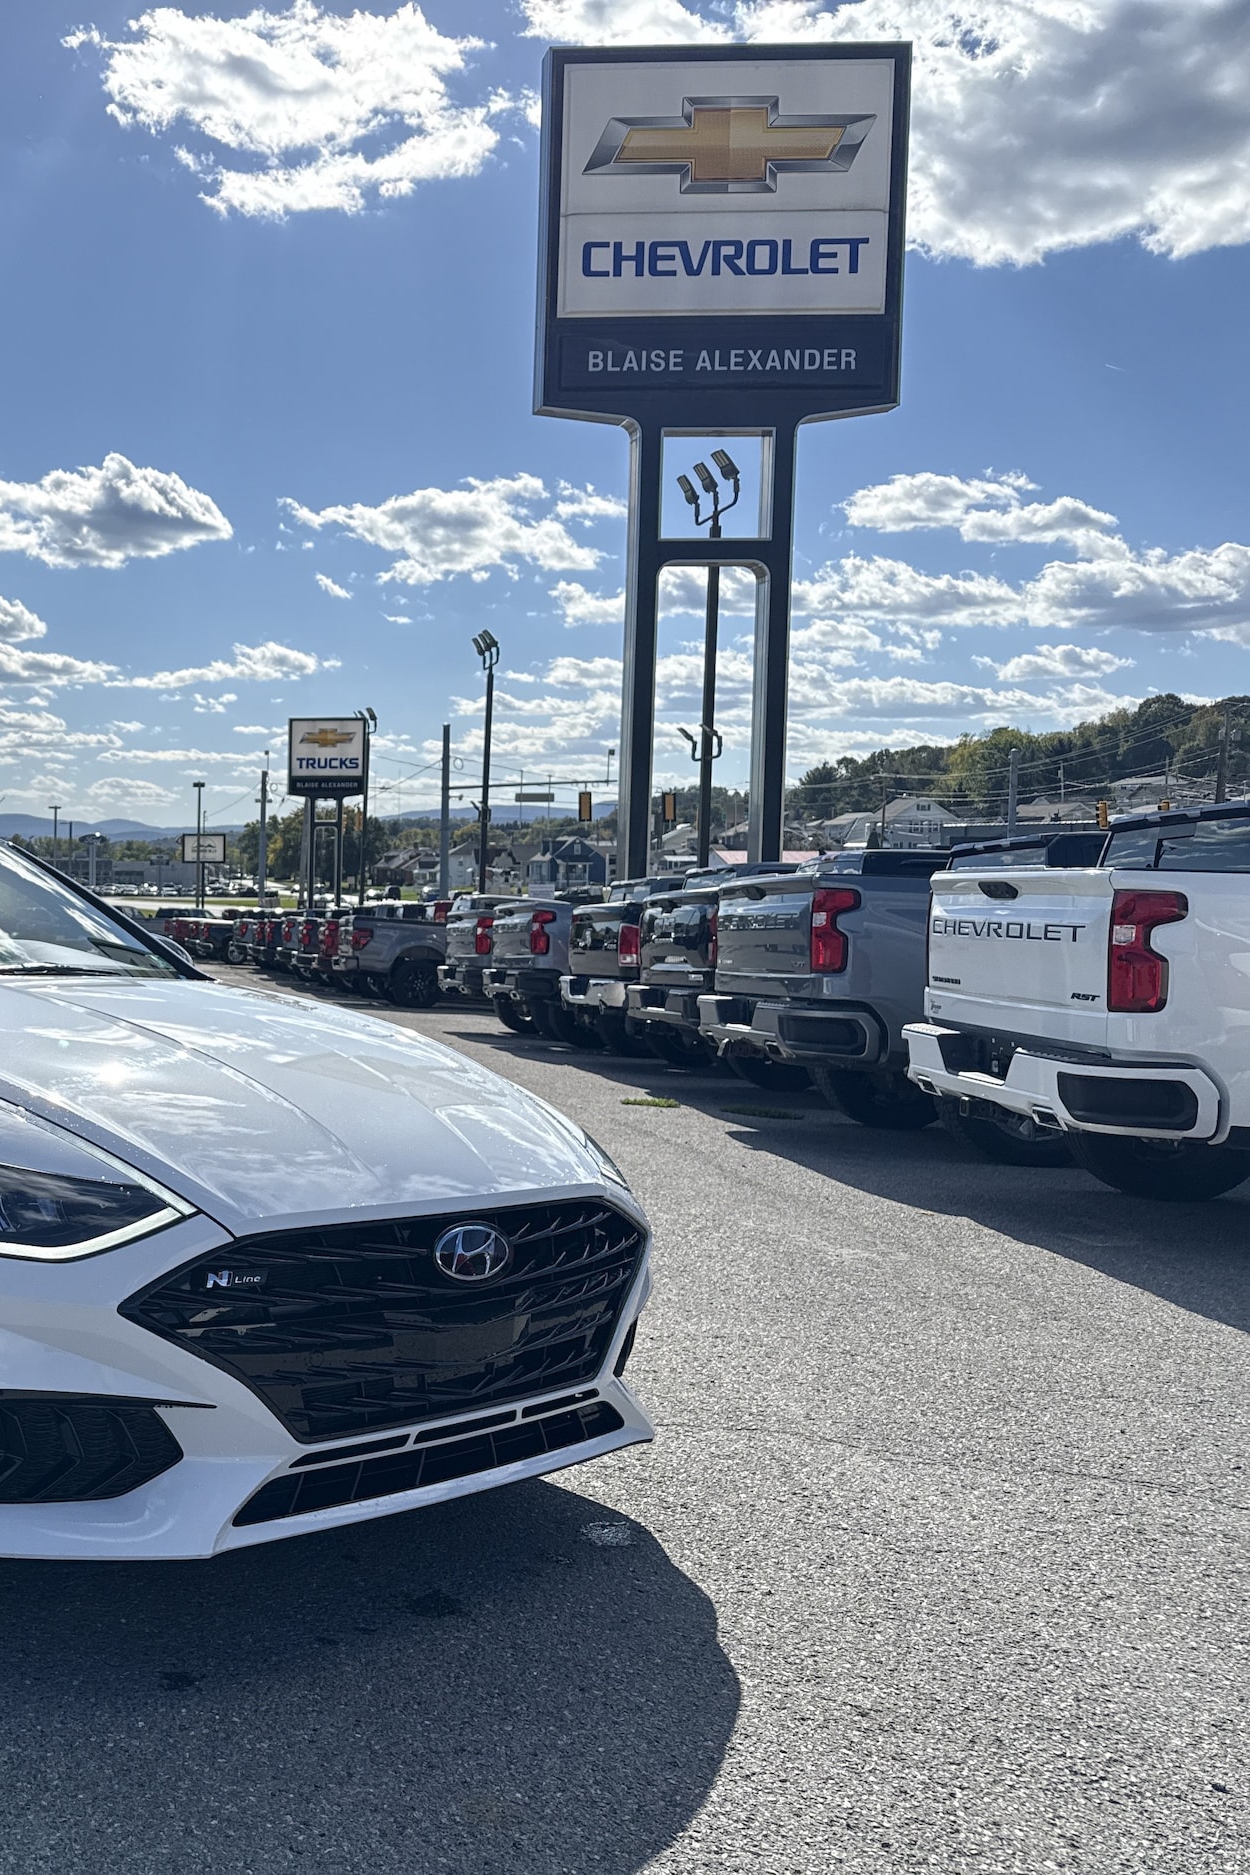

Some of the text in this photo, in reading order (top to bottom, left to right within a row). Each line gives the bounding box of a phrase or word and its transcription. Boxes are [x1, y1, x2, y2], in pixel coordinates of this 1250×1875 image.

[582, 237, 870, 278] CHEVROLET
[587, 349, 857, 372] BLAISE ALEXANDER
[296, 757, 359, 769] TRUCKS
[932, 919, 1086, 943] CHEVROLET
[1070, 992, 1101, 1002] RST
